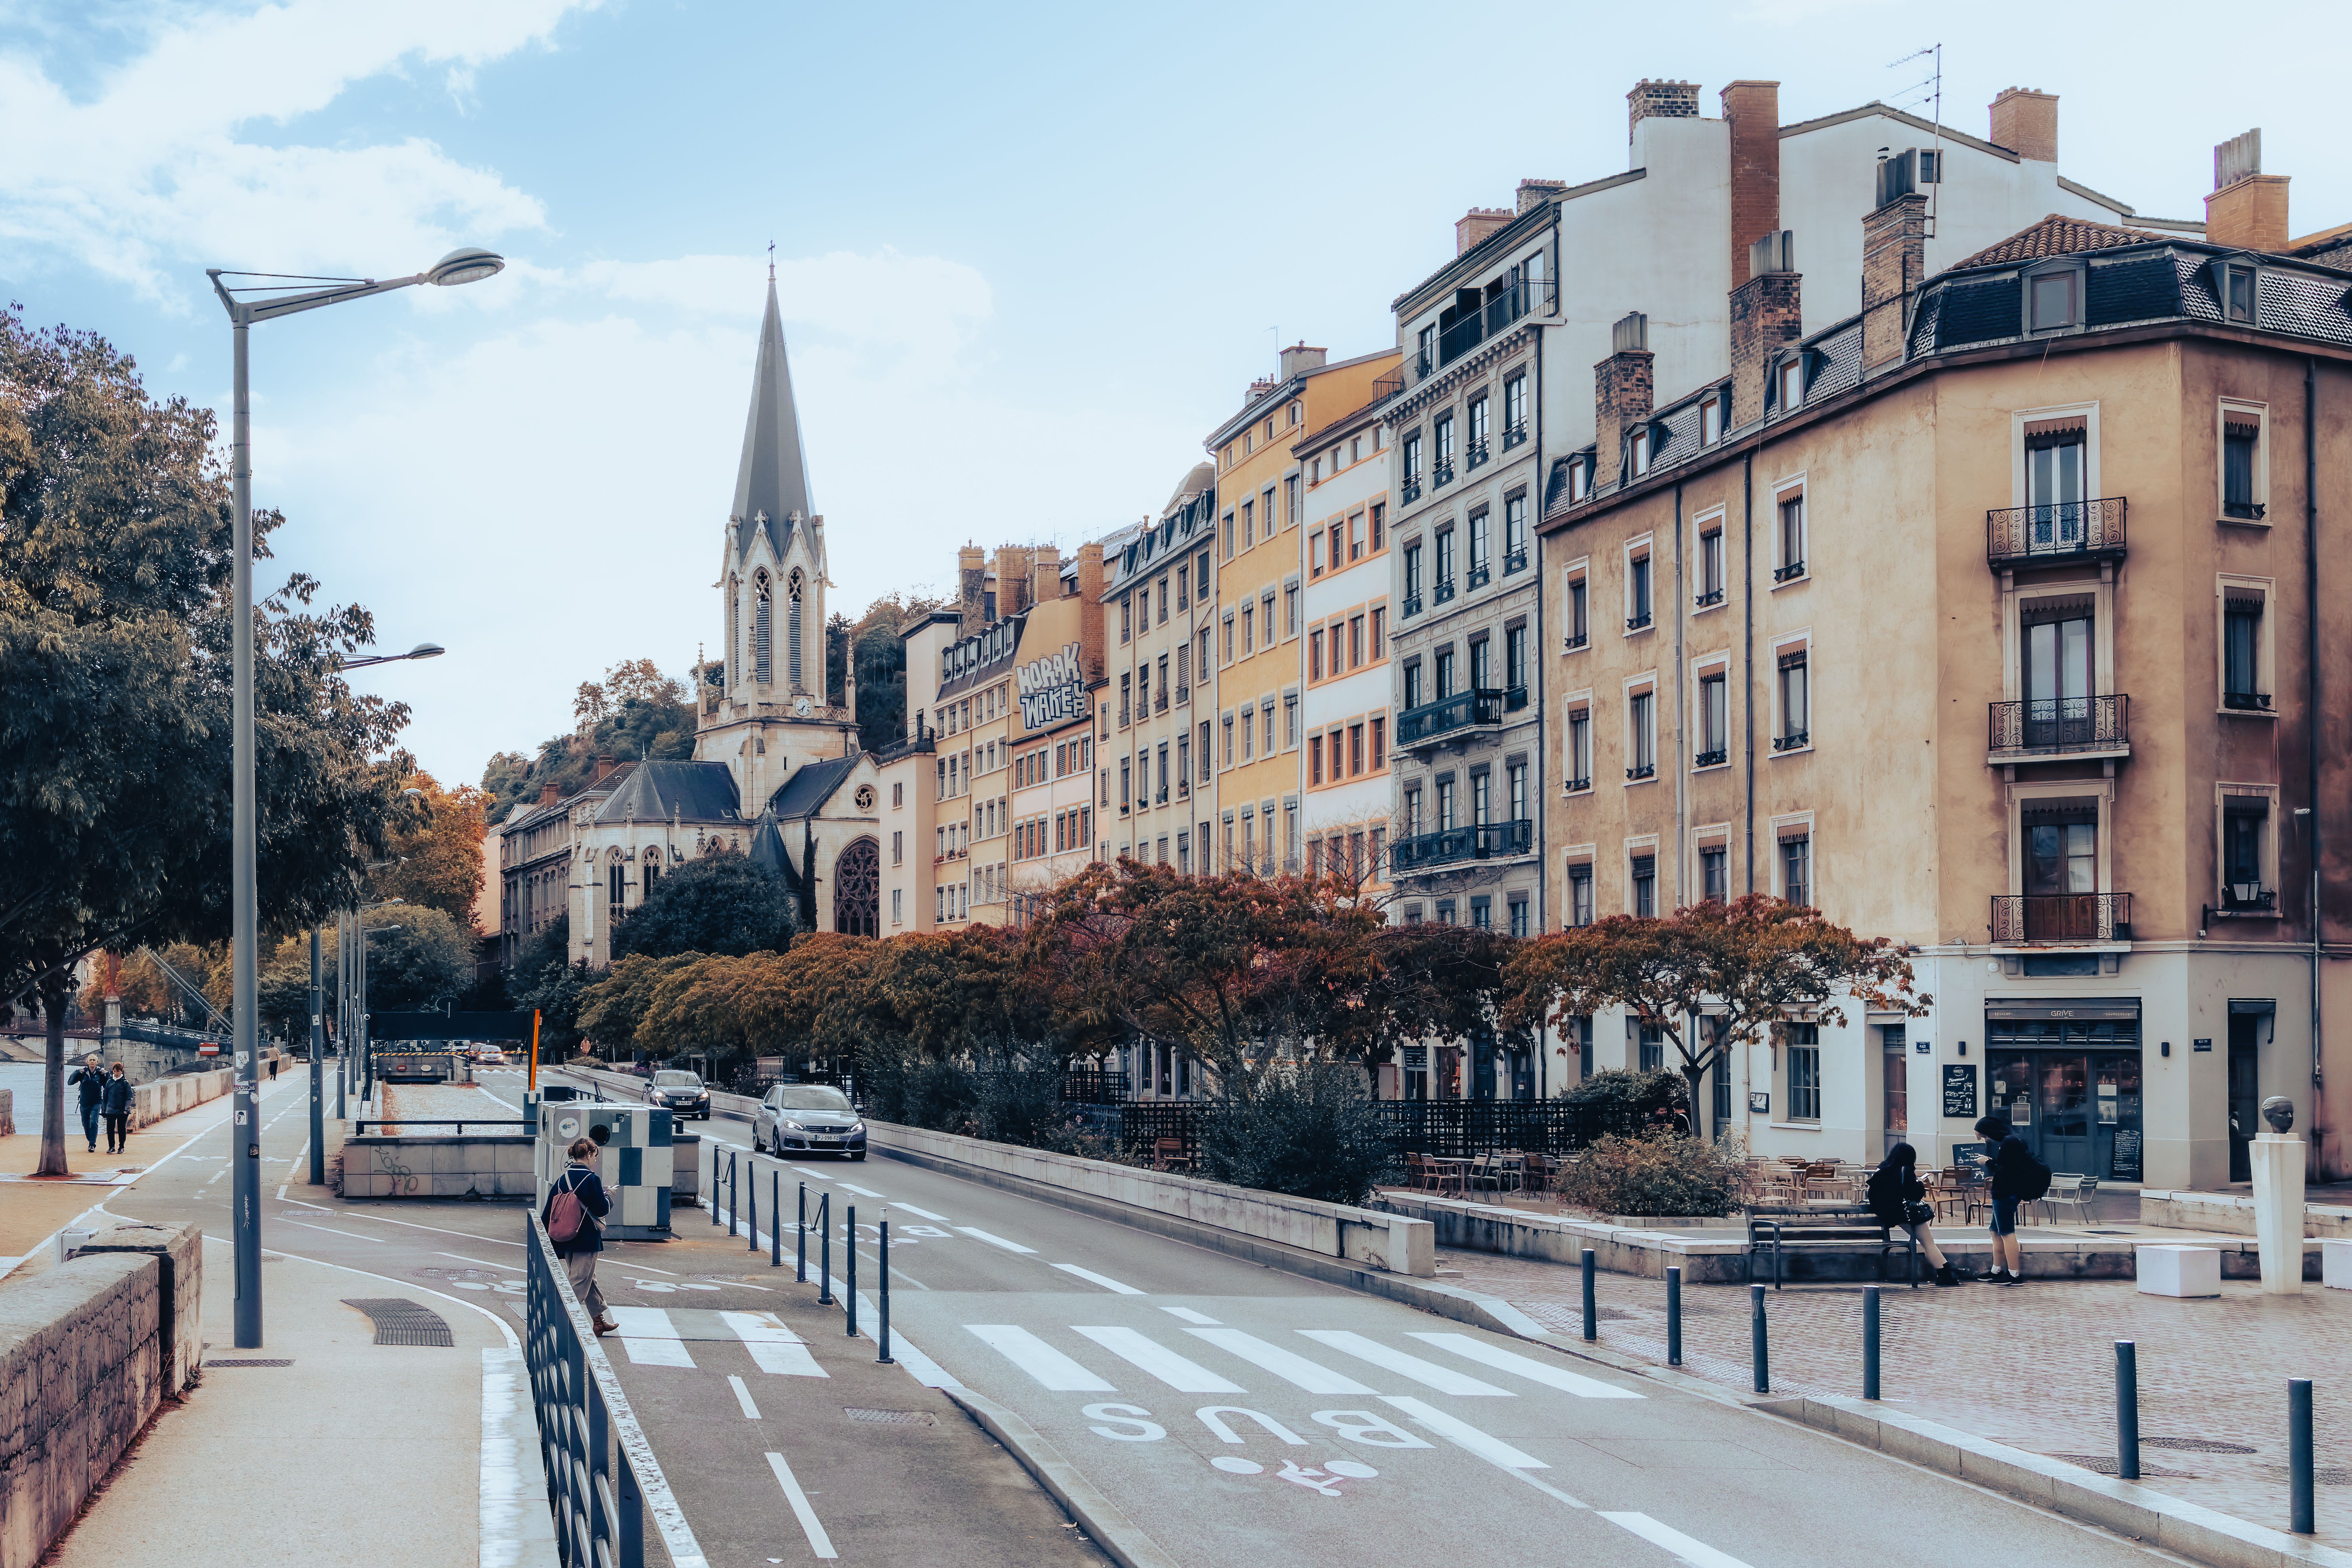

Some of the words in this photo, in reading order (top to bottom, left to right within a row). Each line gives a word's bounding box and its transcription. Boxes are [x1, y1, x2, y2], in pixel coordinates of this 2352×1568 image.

[1015, 641, 1081, 696] HORAK
[1020, 685, 1073, 729] WAKE
[1082, 1402, 1437, 1449] BUS
